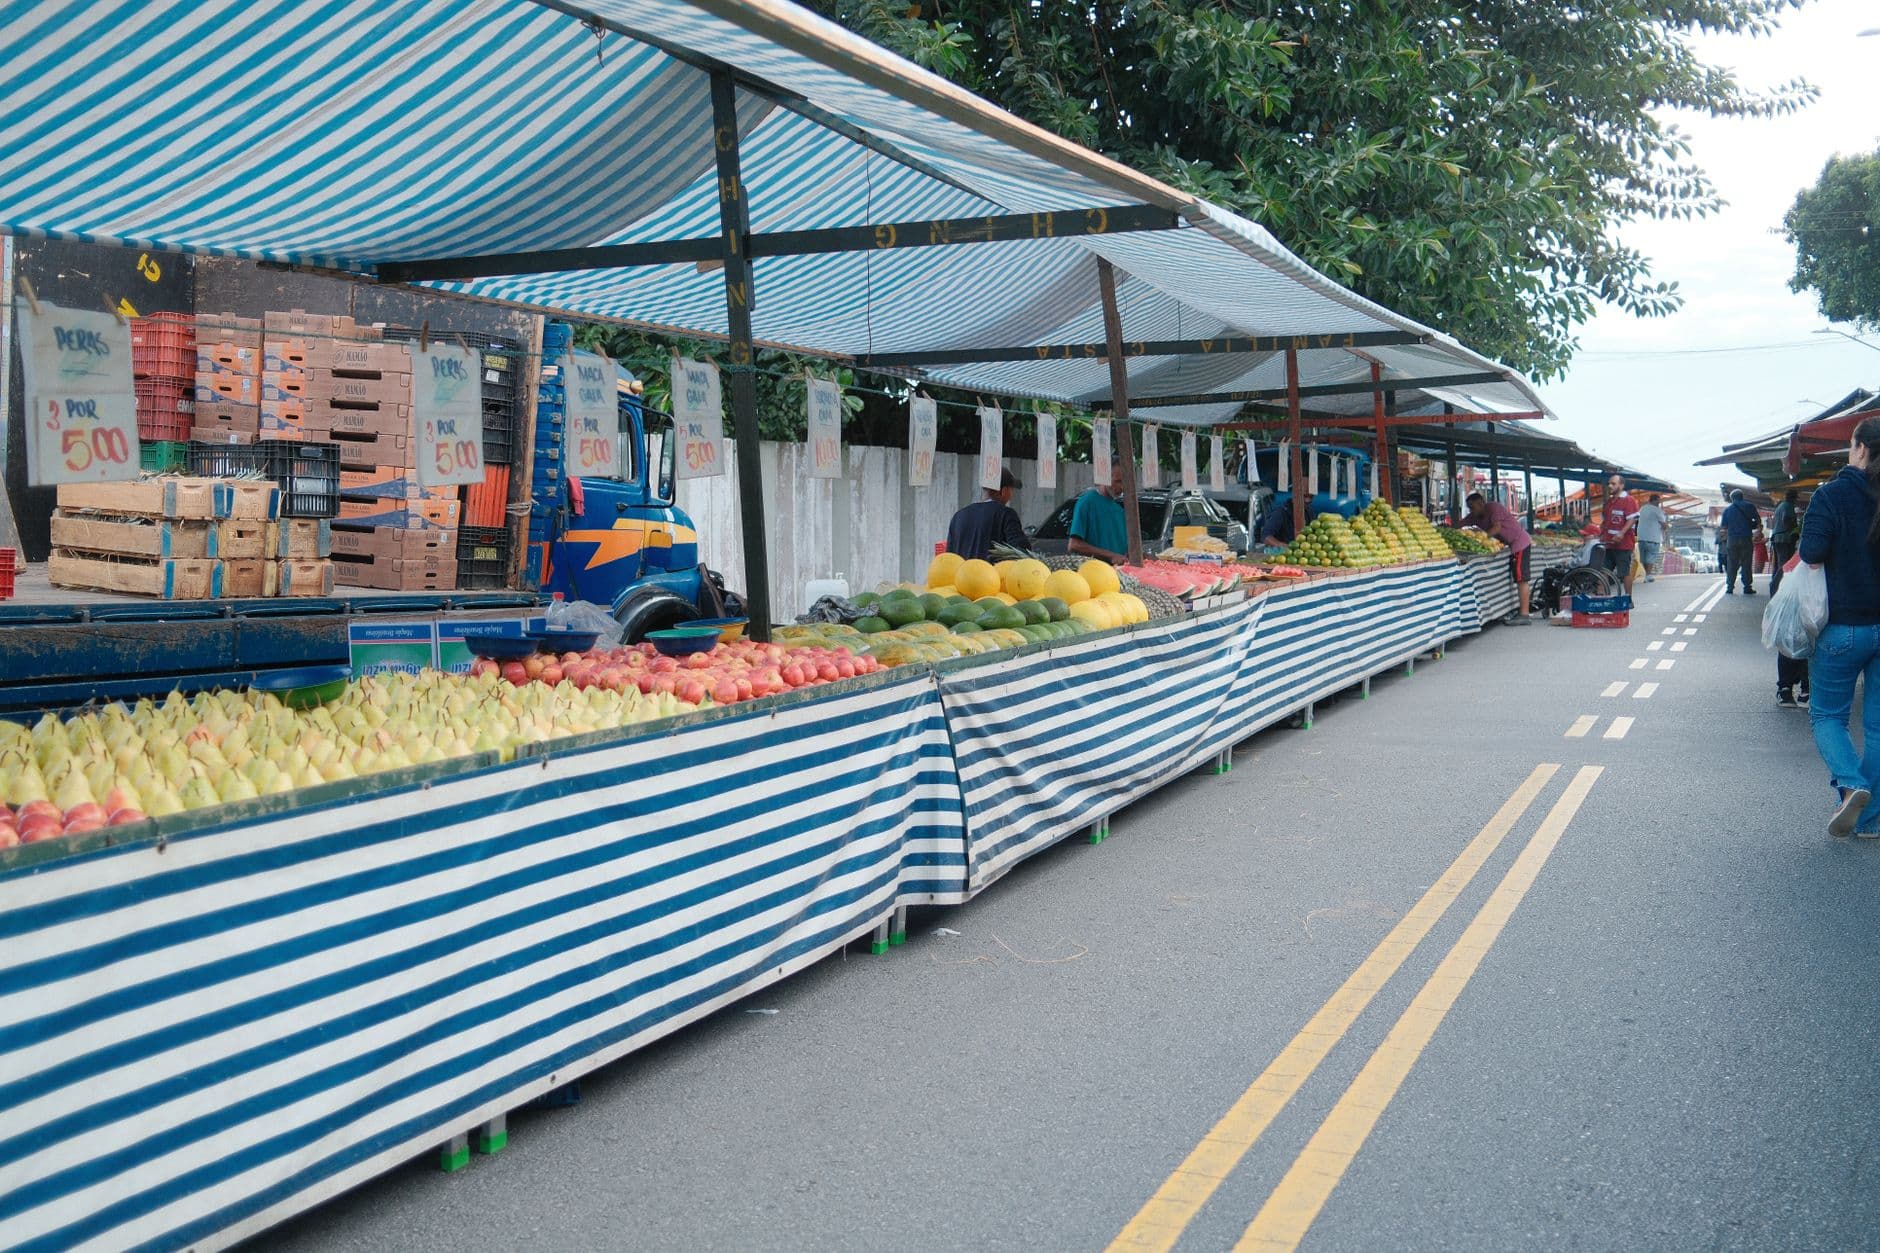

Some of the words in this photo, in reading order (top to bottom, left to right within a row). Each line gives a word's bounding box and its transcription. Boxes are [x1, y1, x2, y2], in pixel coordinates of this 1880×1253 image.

[875, 208, 1108, 248] CHING
[716, 126, 750, 366] CHING
[1036, 342, 1145, 360] CSTA
[46, 399, 60, 431] 3
[65, 398, 100, 420] POR
[574, 419, 583, 435] 5
[583, 417, 600, 434] POR
[425, 421, 434, 443] 3
[437, 419, 458, 436] POR
[688, 423, 705, 438] POR
